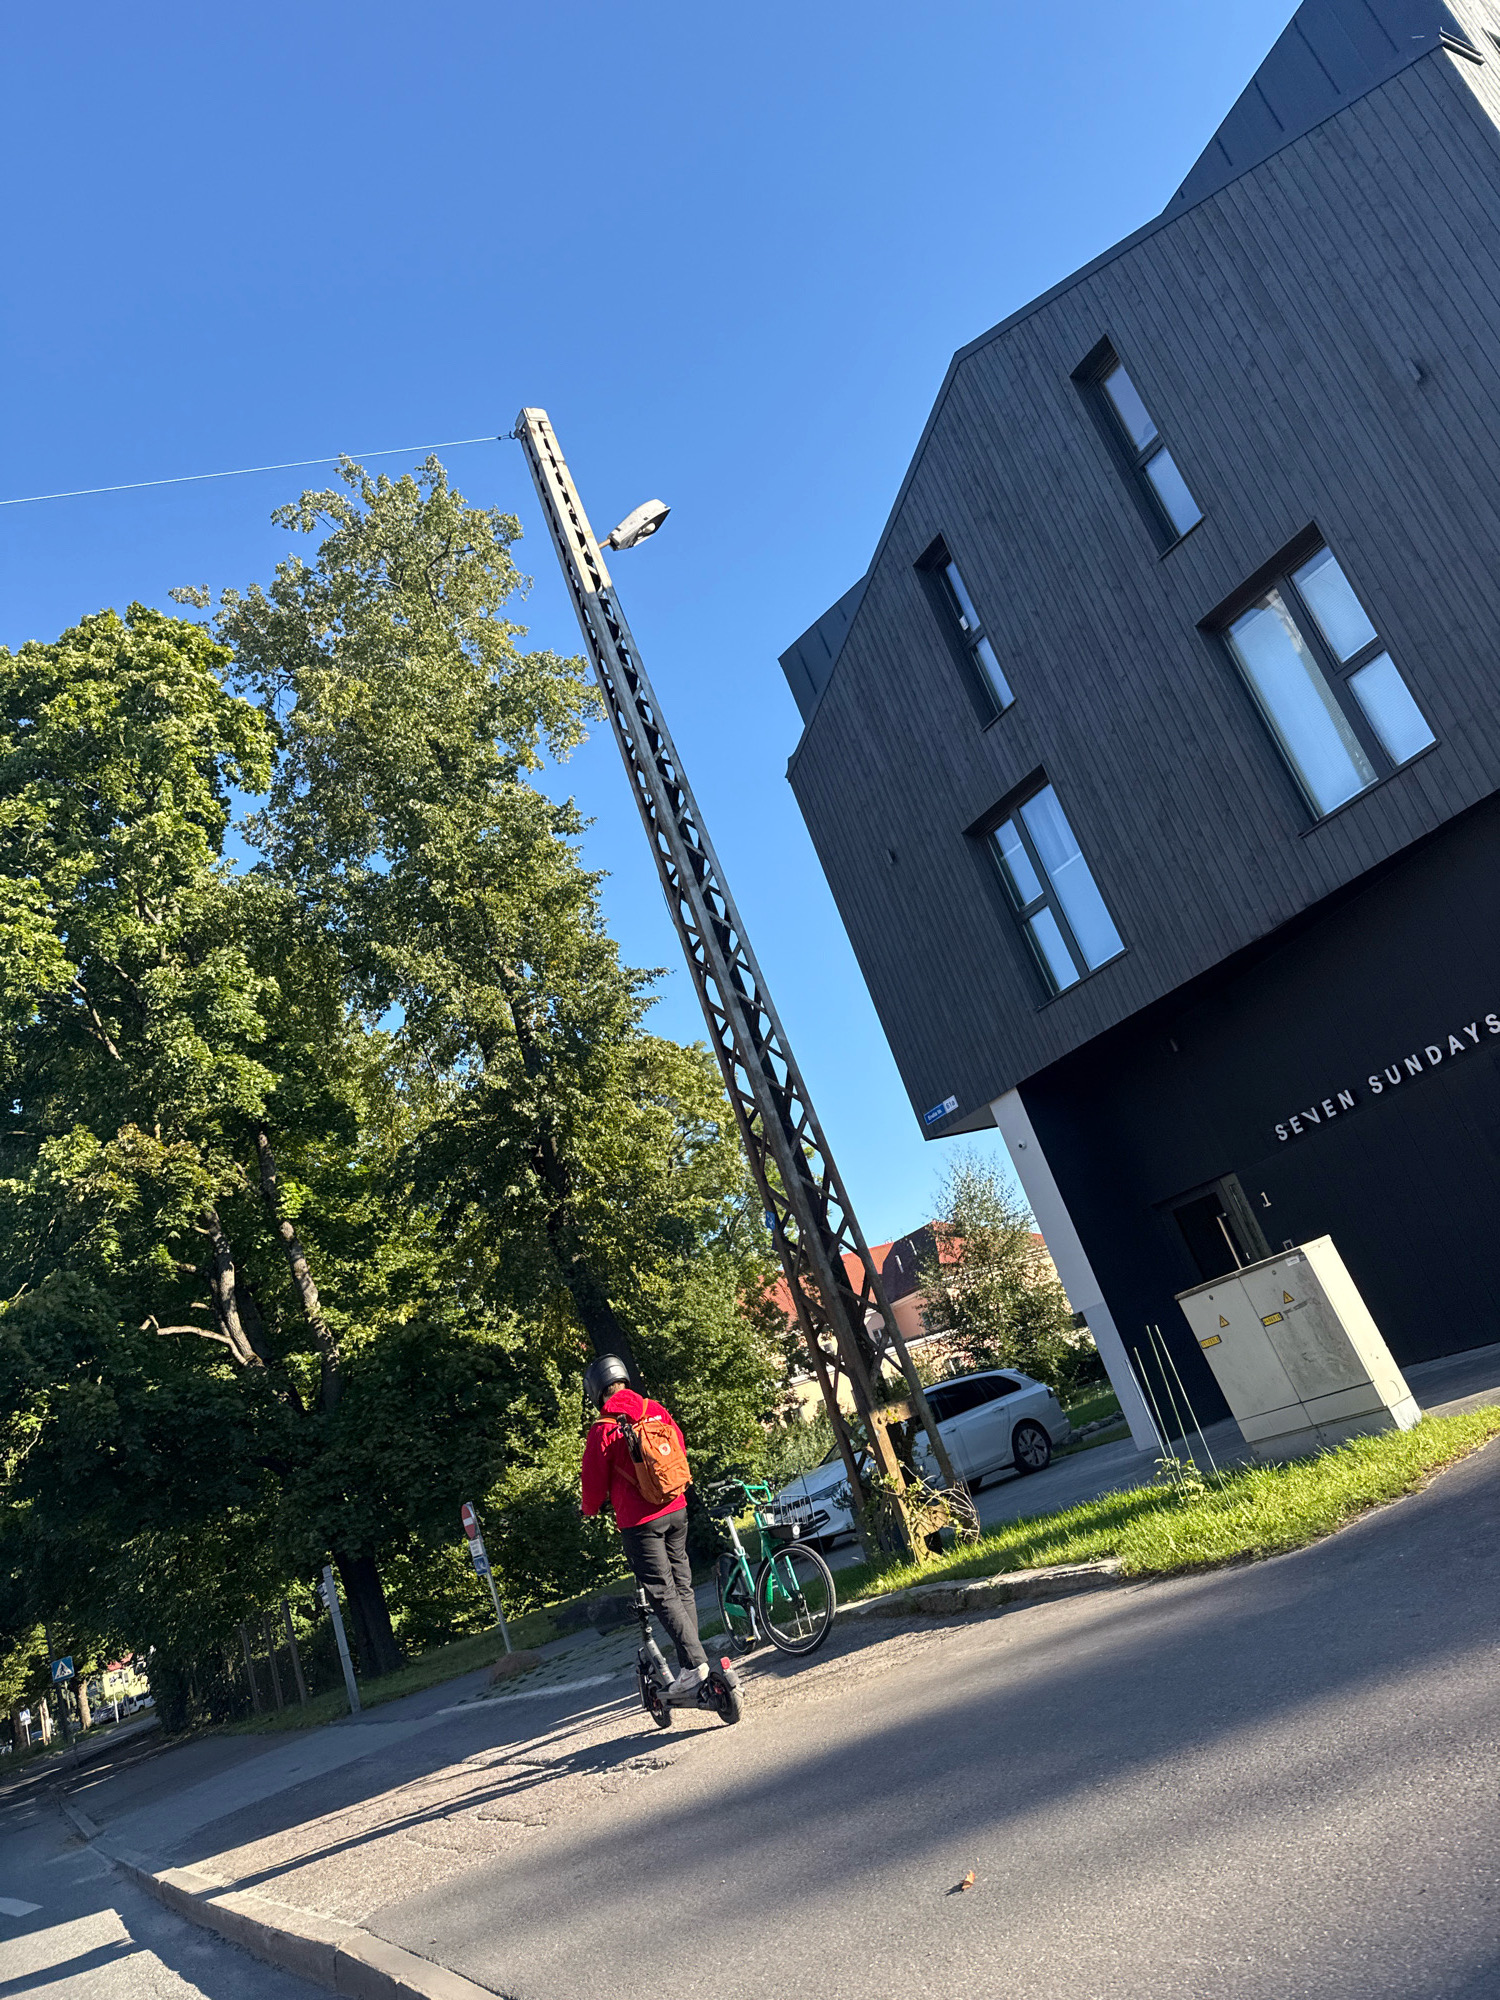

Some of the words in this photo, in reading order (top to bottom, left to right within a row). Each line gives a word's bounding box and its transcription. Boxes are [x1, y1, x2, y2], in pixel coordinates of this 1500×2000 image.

[1275, 1089, 1355, 1141] SEVEN
[1368, 1013, 1500, 1094] SUNDAYS
[1260, 1191, 1272, 1208] 1
